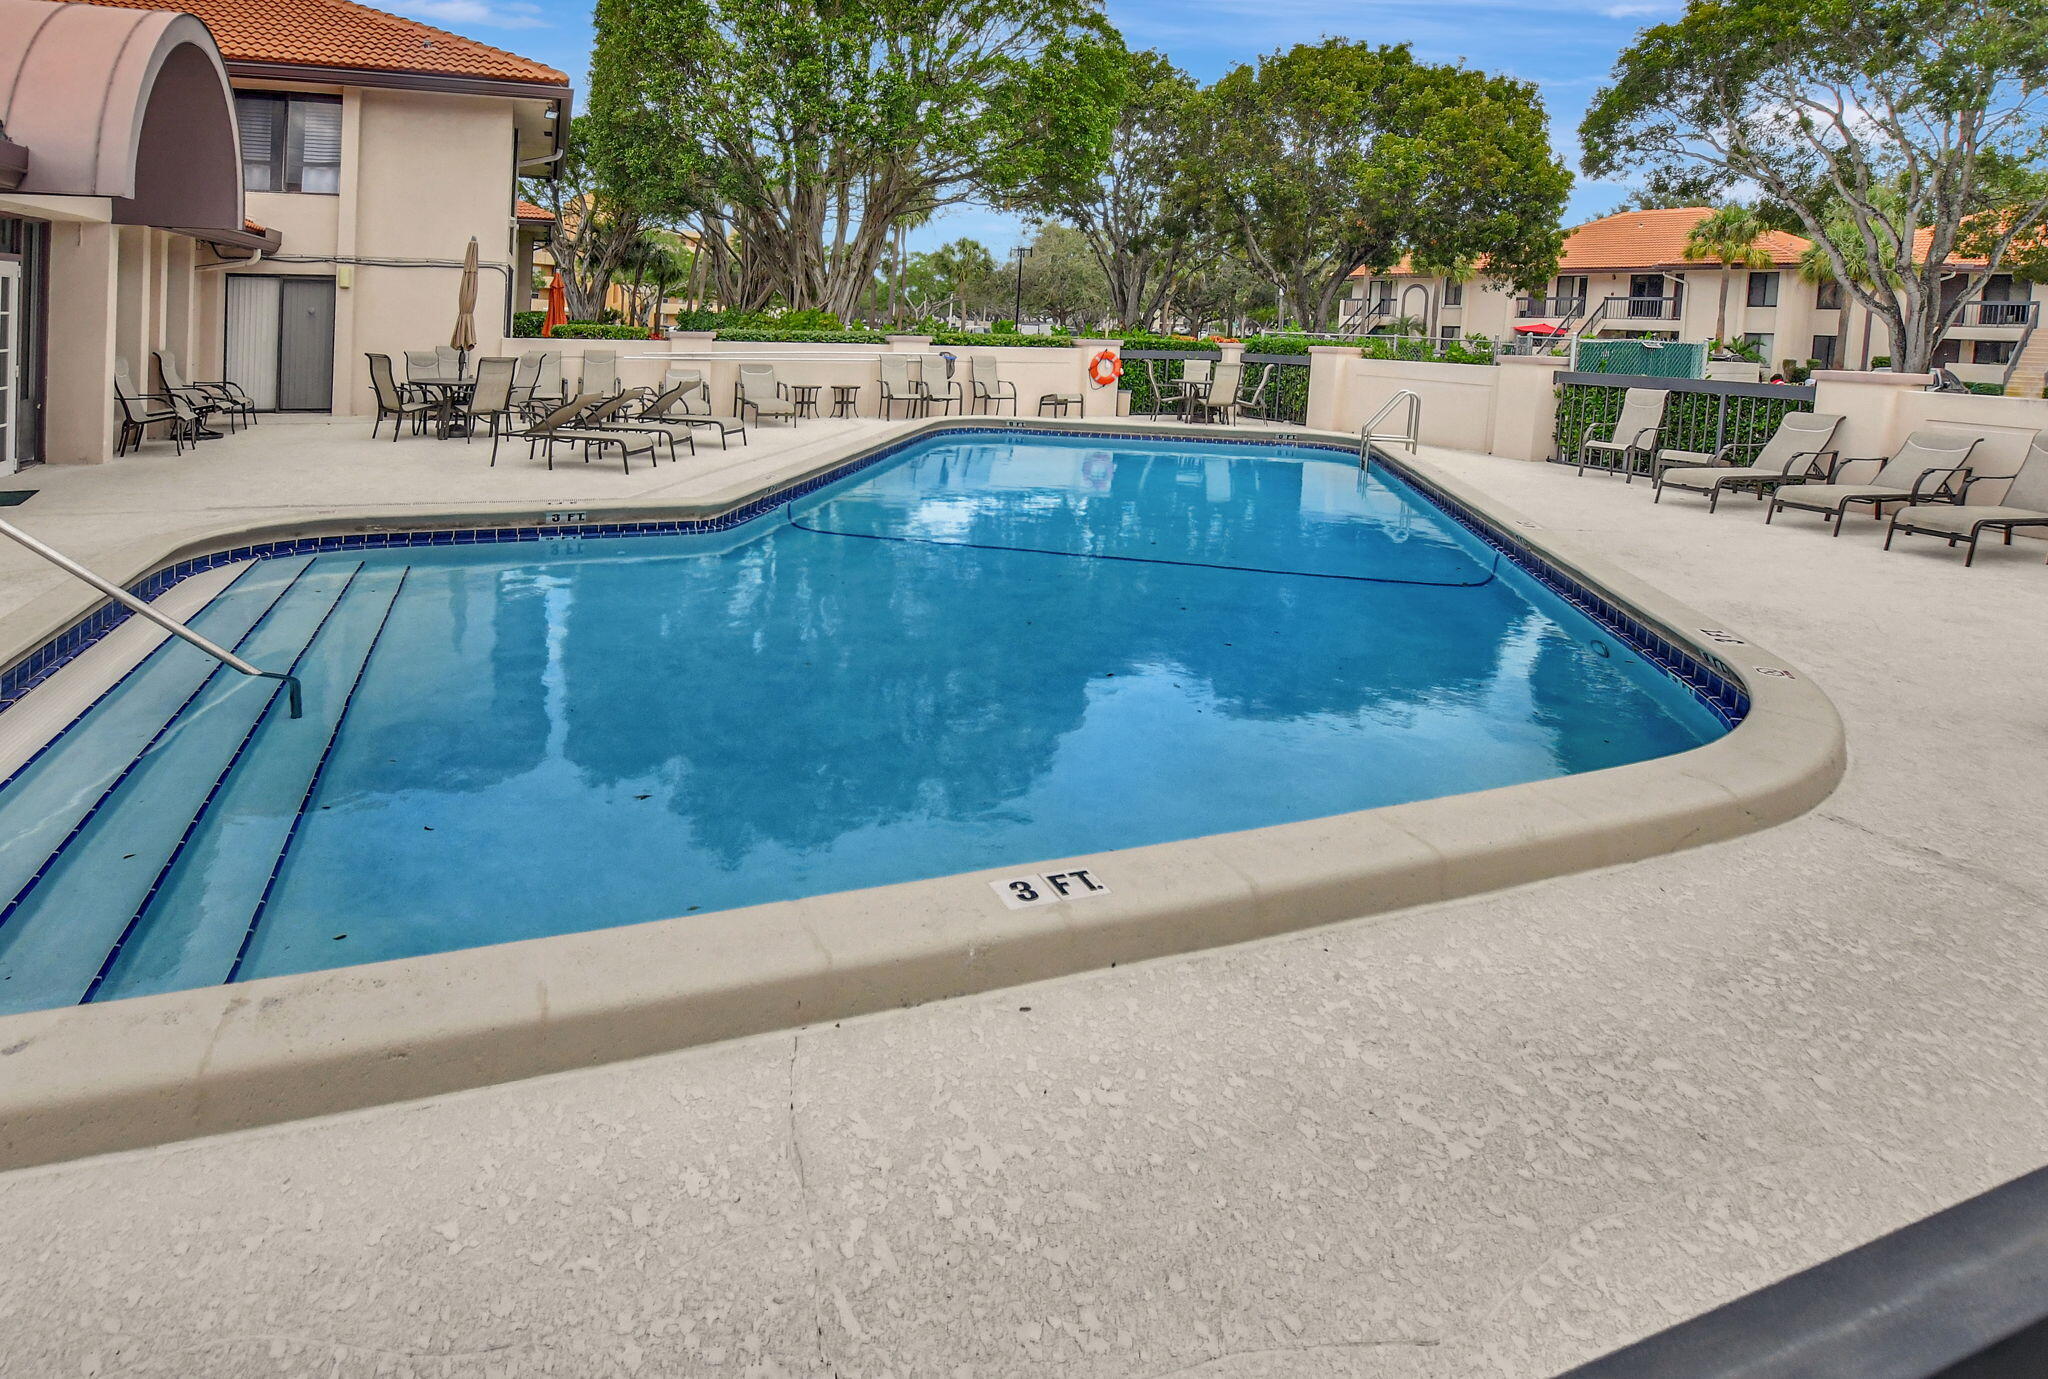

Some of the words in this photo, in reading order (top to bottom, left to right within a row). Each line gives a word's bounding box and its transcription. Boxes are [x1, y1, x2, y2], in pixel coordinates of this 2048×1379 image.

[552, 513, 560, 522] 3
[1009, 881, 1039, 901] 3
[1046, 870, 1103, 896] FT.
